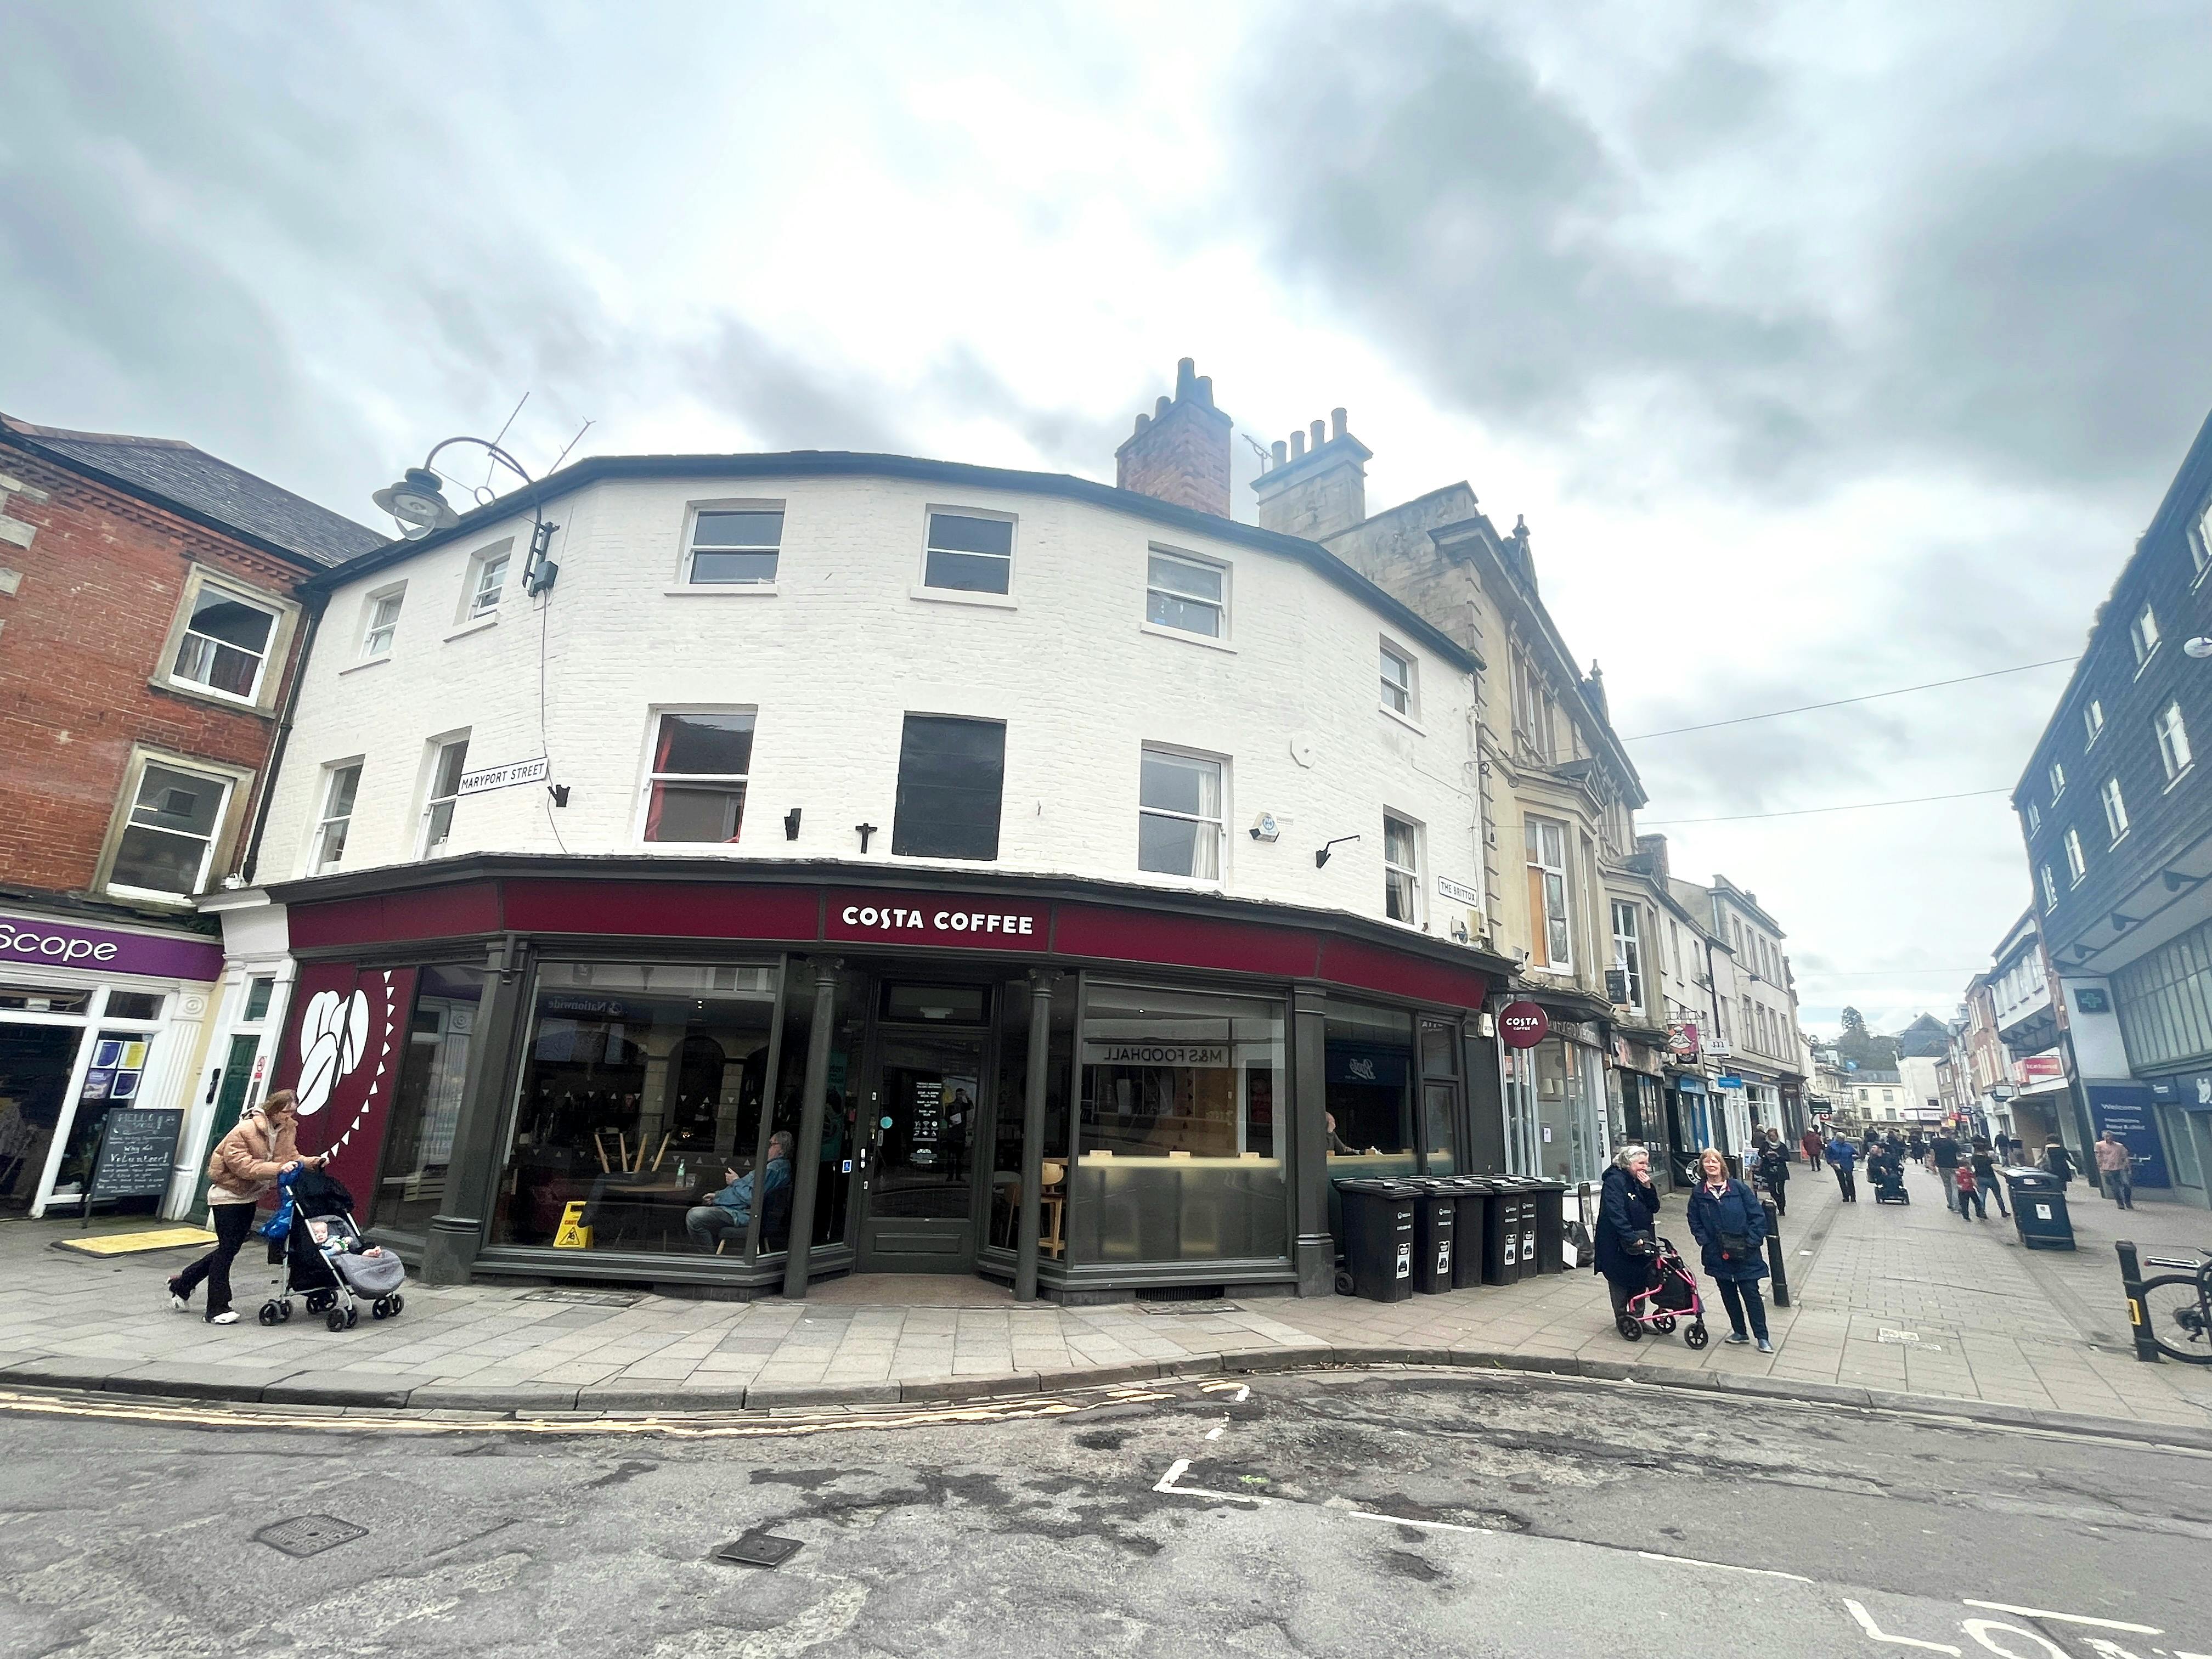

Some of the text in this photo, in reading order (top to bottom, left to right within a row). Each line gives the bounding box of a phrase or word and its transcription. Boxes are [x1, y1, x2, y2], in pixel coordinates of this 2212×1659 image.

[461, 763, 545, 789] MARYPORT STREET
[1441, 881, 1475, 902] THE BRITTOX
[842, 906, 1033, 935] COSTA COFFEE
[0, 924, 118, 962] Scope
[1505, 1017, 1538, 1026] COSTA
